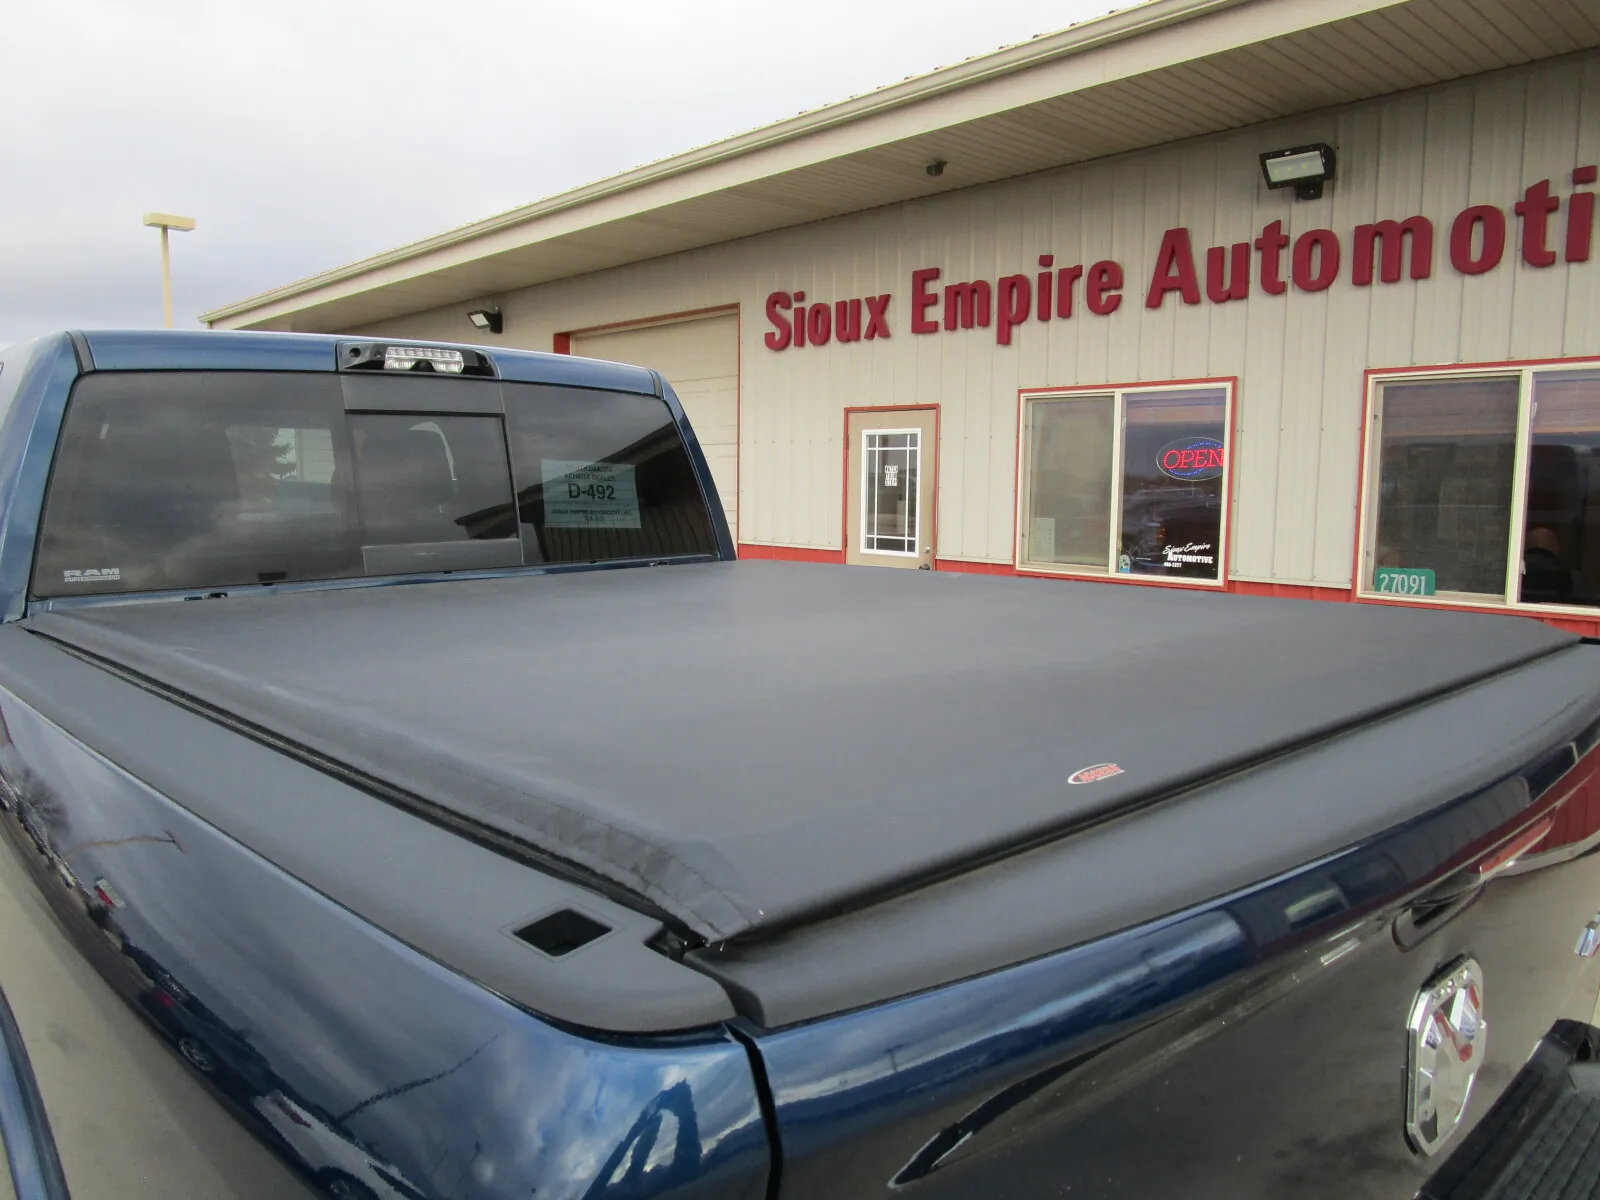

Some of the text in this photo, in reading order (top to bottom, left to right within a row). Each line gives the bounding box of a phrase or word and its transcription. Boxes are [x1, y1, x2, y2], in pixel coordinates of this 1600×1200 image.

[764, 164, 1597, 352] Sioux Empire Automoti
[1163, 448, 1224, 469] OPEN
[568, 482, 616, 500] D-492
[1183, 542, 1211, 553] Empire
[63, 568, 120, 577] RAM
[1380, 573, 1426, 596] 27091
